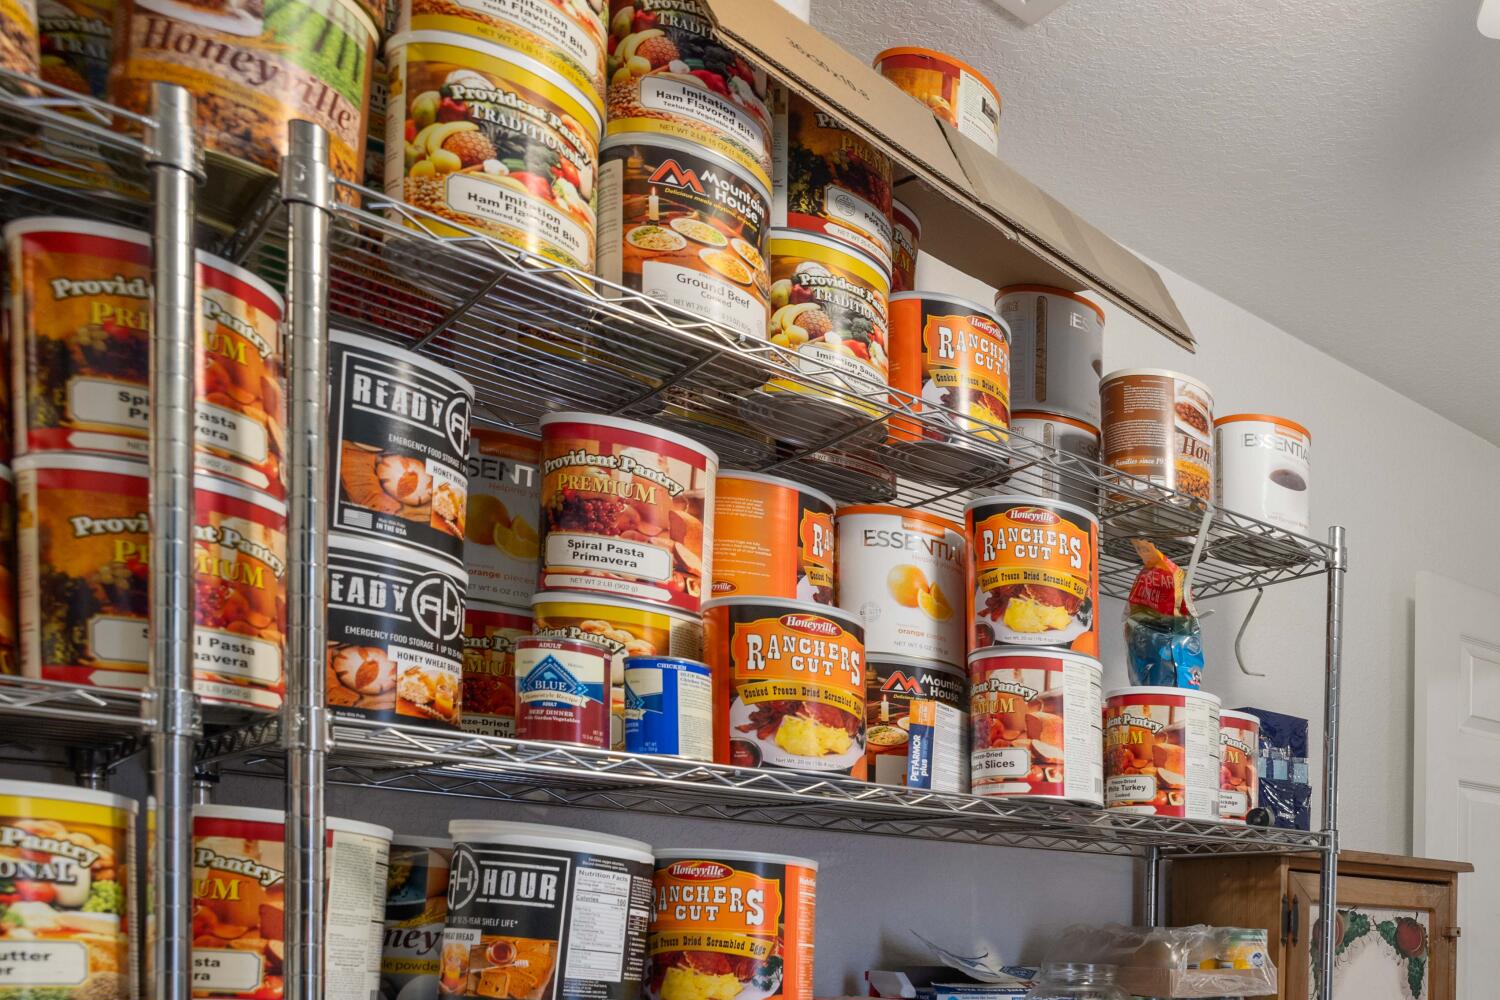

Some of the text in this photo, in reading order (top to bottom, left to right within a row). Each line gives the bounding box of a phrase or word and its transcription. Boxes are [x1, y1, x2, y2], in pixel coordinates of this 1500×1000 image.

[570, 36, 588, 56] Bits
[682, 87, 736, 118] Imitation
[451, 85, 592, 165] Provident Pantry
[656, 90, 755, 141] Ham Flavored Bits
[659, 123, 688, 135] NET WT
[701, 170, 765, 218] Mountain
[500, 191, 560, 225] Imittion
[715, 189, 758, 225] House
[467, 192, 579, 249] Ham Flared Bits
[676, 272, 751, 309] Ground Beef
[799, 273, 864, 300] Provident
[203, 297, 271, 359] Pantry
[975, 353, 1002, 375] CUT
[352, 373, 443, 427] READY
[388, 434, 441, 459] EMERGENCY FOOD
[433, 466, 452, 480] HONEY
[545, 448, 684, 497] Provident Pantry
[557, 473, 658, 505] PREMIUM
[1010, 508, 1056, 524] Honeyville
[220, 527, 285, 577] Pantry
[567, 539, 645, 559] Spiral Pasta
[572, 551, 638, 569] Primavera
[982, 527, 1083, 570] RANCHERS
[1014, 543, 1052, 561] CUT
[330, 573, 409, 614] EADY
[570, 577, 597, 587] NET WT
[981, 577, 999, 591] Cooked
[1000, 573, 1021, 585] Freeze
[1023, 572, 1041, 583] Dried
[1042, 575, 1073, 591] Scrambled
[787, 614, 837, 635] Honeyville
[209, 637, 256, 656] Pasta
[345, 626, 434, 651] EMERGENCY FOOD STORAGE
[569, 627, 626, 655] Pantry
[397, 652, 445, 669] HONEY WHEAT
[657, 662, 687, 671] CHICKEN
[746, 633, 860, 686] RANCHERS
[791, 655, 834, 675] CUT
[535, 680, 567, 692] BLUE
[744, 685, 852, 711] Cooked Freeze Dried Scrambled
[989, 678, 1038, 702] Pantry
[1122, 713, 1164, 736] Pantry
[910, 735, 921, 782] PETARMOR
[985, 760, 1015, 769] Slices
[1119, 783, 1147, 794] Turkey
[0, 827, 99, 868] Pantry
[195, 848, 283, 886] Pantry
[579, 869, 628, 883] Nutrition Facts
[673, 863, 723, 877] Honeyville
[482, 867, 558, 902] HOUR
[675, 905, 719, 921] CUT
[683, 935, 767, 958] Dried Scrambled Eggs
